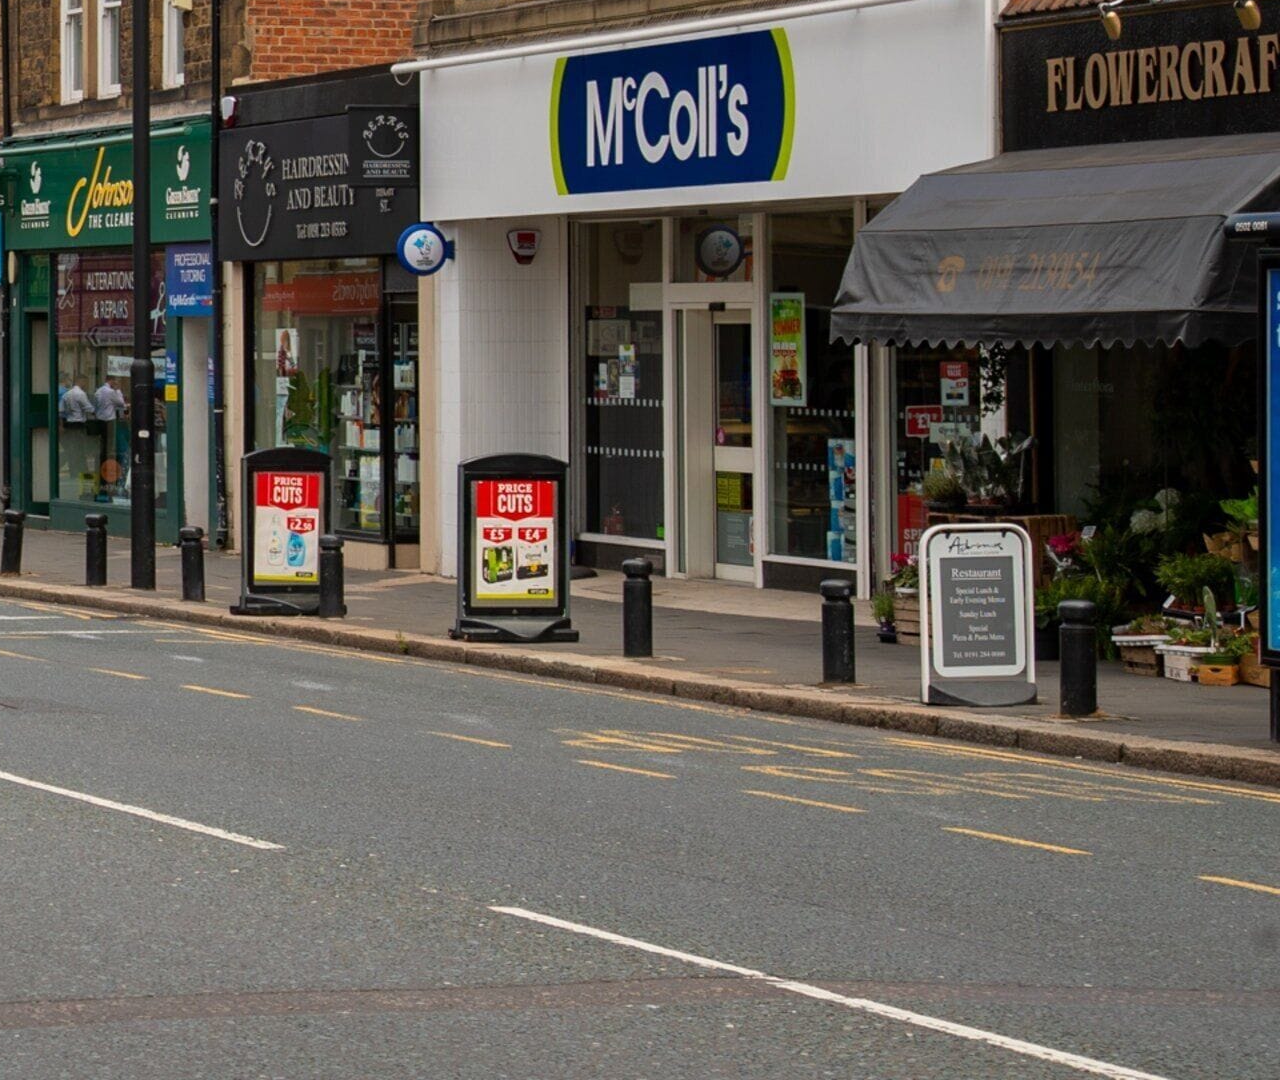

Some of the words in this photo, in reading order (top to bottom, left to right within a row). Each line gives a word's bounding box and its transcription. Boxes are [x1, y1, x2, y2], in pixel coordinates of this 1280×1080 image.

[586, 64, 749, 167] McColl's
[363, 115, 409, 139] BERRY'S
[282, 153, 350, 180] HAIRDRESSIN
[66, 146, 134, 237] Johnso
[286, 188, 311, 210] AND
[314, 184, 355, 208] BEAUTY
[88, 214, 102, 229] THE
[105, 212, 134, 228] CLEANE
[166, 210, 199, 220] CLEANING
[21, 221, 50, 230] CLEANING
[174, 252, 211, 267] PROFESSIONAL
[86, 271, 134, 291] ALTERATIONS
[180, 270, 206, 283] TUTORING
[93, 302, 99, 319] &
[100, 300, 129, 319] REPAIRS
[274, 476, 303, 486] PRICE
[498, 484, 533, 493] PRICE
[273, 486, 303, 504] CUTS
[498, 494, 533, 513] CUTS
[290, 519, 313, 531] £2.50
[490, 529, 505, 540] £5
[525, 529, 540, 540] £4
[904, 529, 922, 540] SPE
[951, 568, 1002, 578] Restaurant
[956, 587, 975, 596] Special
[950, 597, 964, 605] Early
[965, 597, 987, 605] Evening
[960, 610, 979, 619] Sunday
[980, 610, 997, 618] Lunch
[968, 624, 989, 633] Special
[952, 634, 967, 642] Pizza
